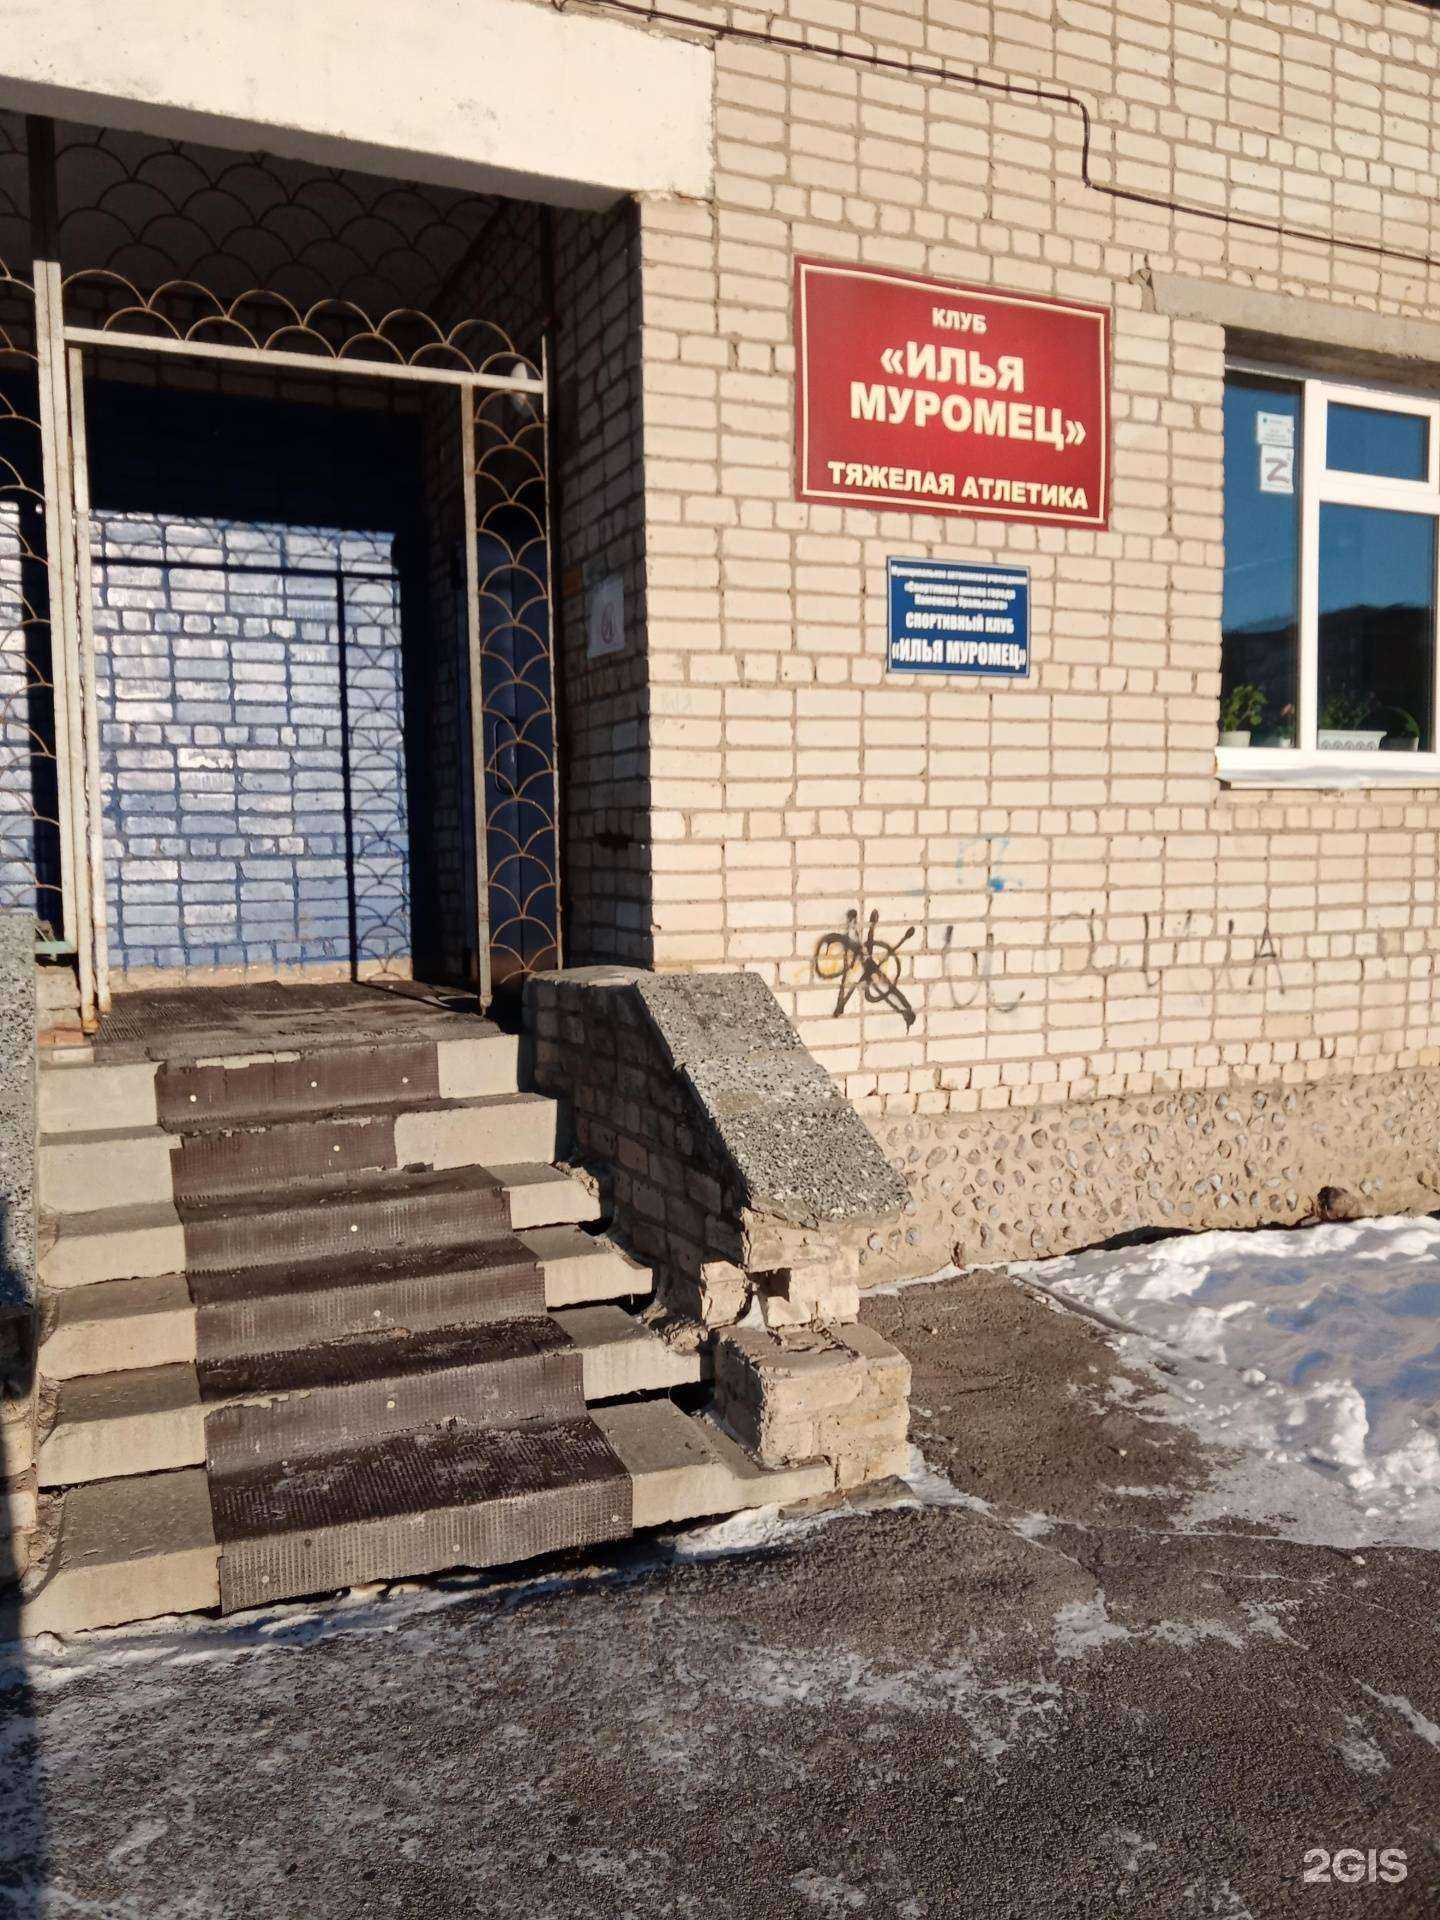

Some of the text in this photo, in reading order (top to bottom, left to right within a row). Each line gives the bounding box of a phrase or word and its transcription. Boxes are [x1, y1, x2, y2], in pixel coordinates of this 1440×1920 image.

[932, 307, 987, 335] КЛУБ
[880, 340, 1025, 393] «ИЛЬЯ
[850, 381, 1087, 452] МУРОМЕЦ»
[827, 460, 1089, 511] ТЯЖЕЛАЯ АТЛЕТИКА
[905, 611, 1015, 634] СПОРТИВНЫЙ КЛУБ
[891, 637, 1027, 671] «ИЛЬЯ МУРОМЕЦ»
